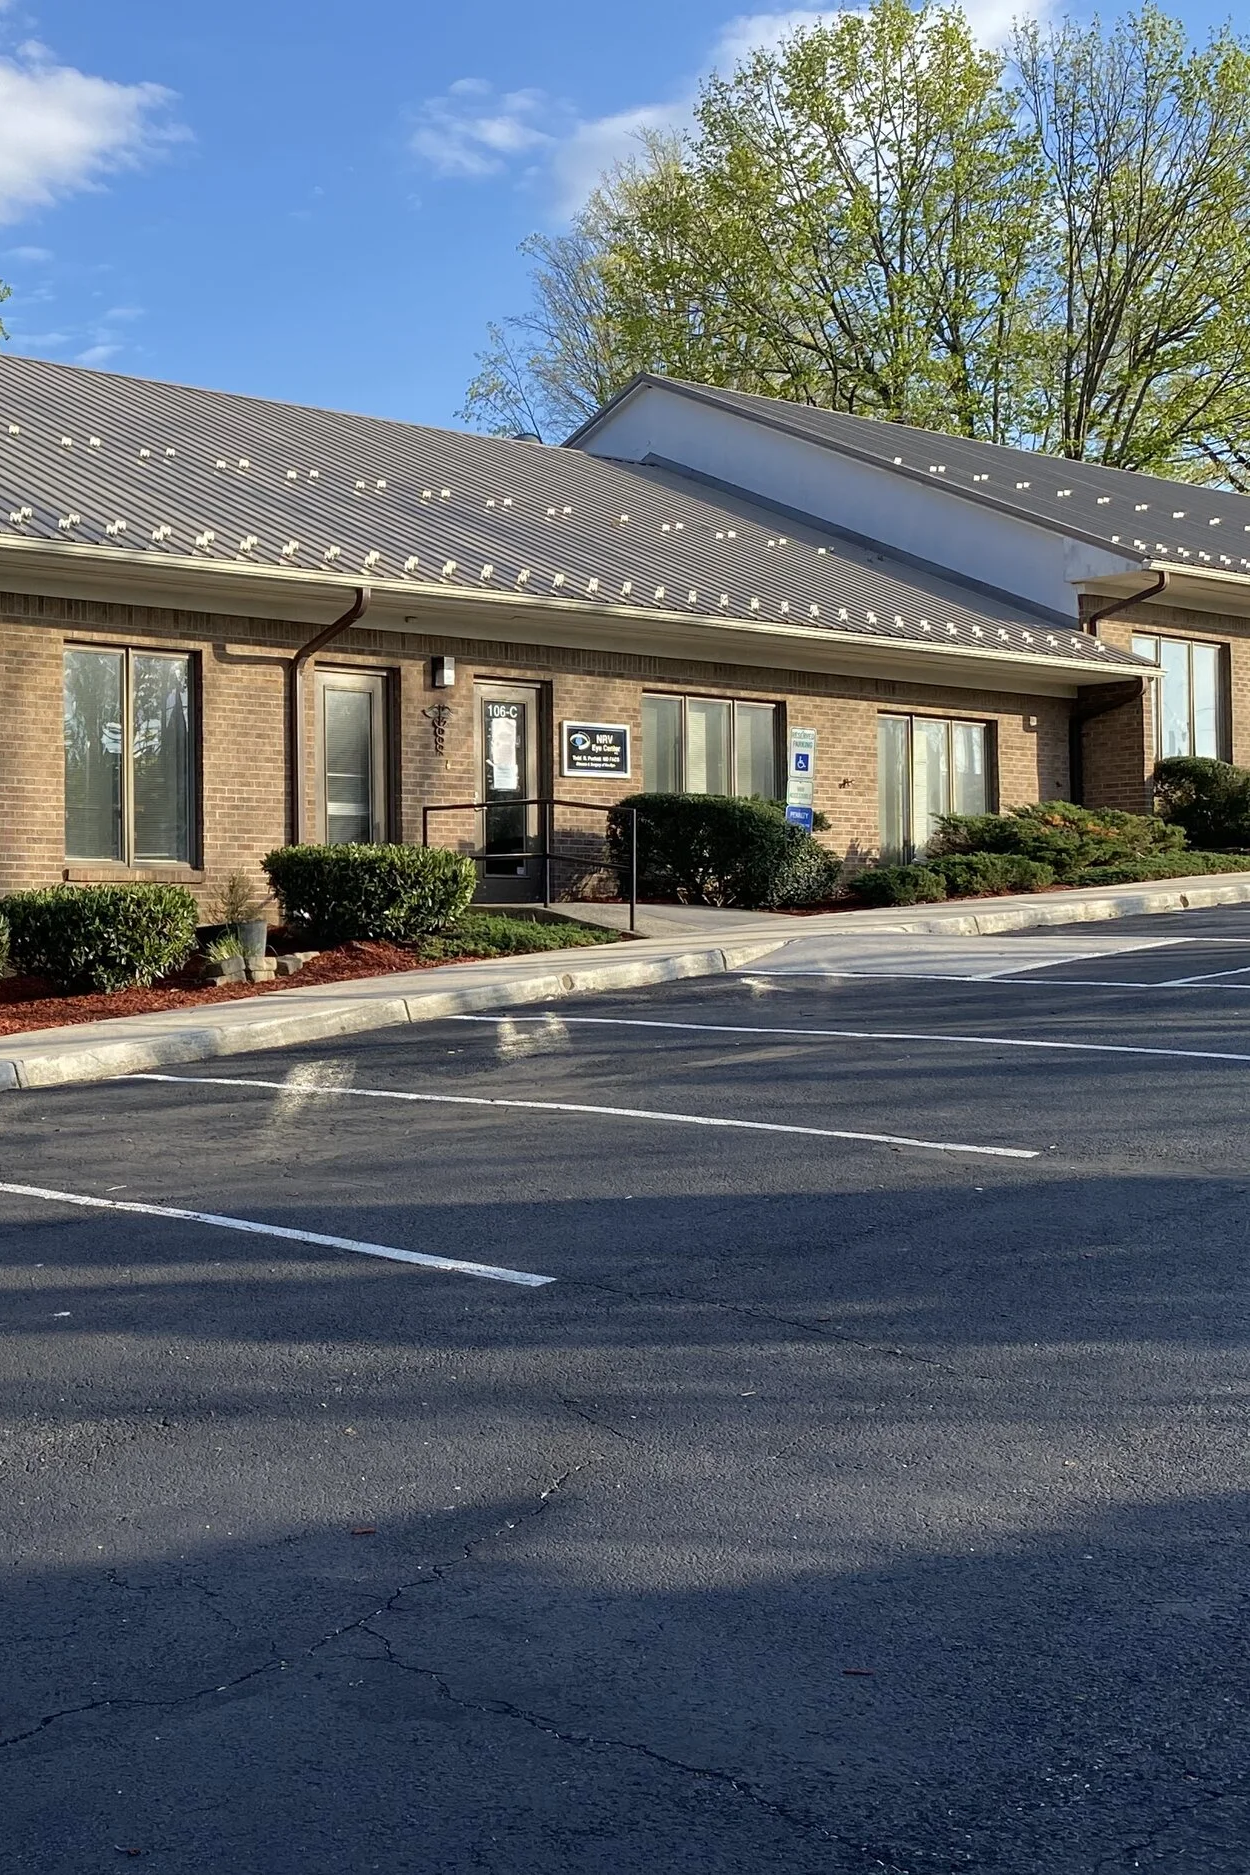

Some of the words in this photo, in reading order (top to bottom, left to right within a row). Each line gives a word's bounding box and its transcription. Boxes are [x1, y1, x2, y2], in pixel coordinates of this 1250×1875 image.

[487, 704, 518, 718] 106-C
[596, 734, 613, 744] NRV
[592, 744, 602, 753] Eye
[790, 811, 809, 820] PENALTY
